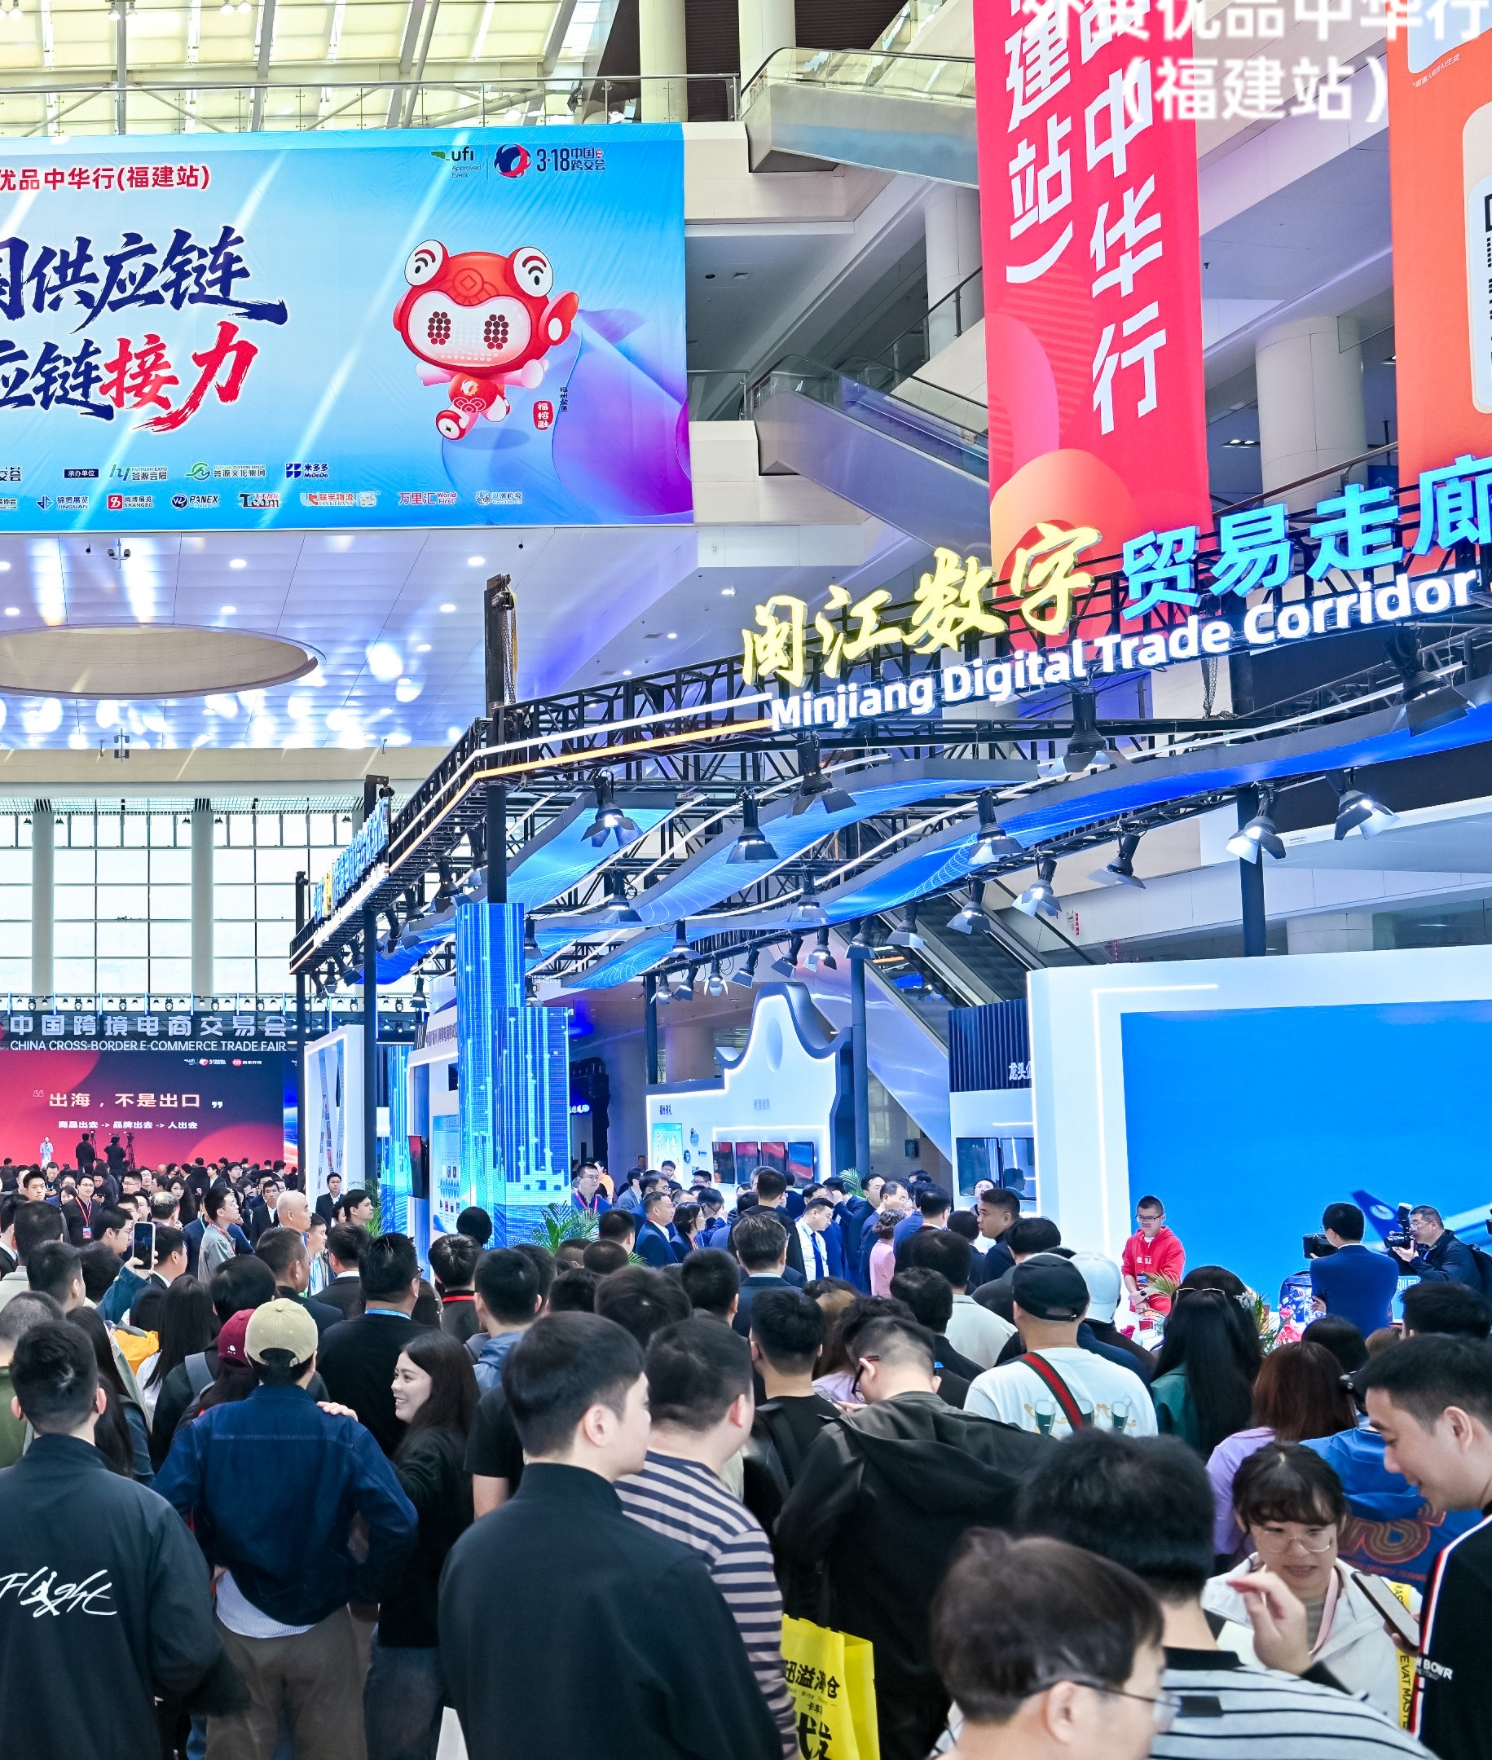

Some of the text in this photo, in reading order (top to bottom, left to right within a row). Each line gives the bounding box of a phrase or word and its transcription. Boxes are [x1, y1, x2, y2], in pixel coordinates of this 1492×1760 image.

[452, 146, 474, 161] ufi
[304, 463, 328, 471] 米多多
[770, 566, 1477, 732] Minjiang Digital Trade Corridor
[10, 1015, 286, 1037] 中国跨境电商交易会
[10, 1041, 286, 1051] CHINA CROSS-BORDER E-COMMERCE TRADE FAIR
[58, 1121, 98, 1129] 商品出去
[113, 1121, 153, 1129] 品牌出去
[168, 1121, 198, 1129] 人出去
